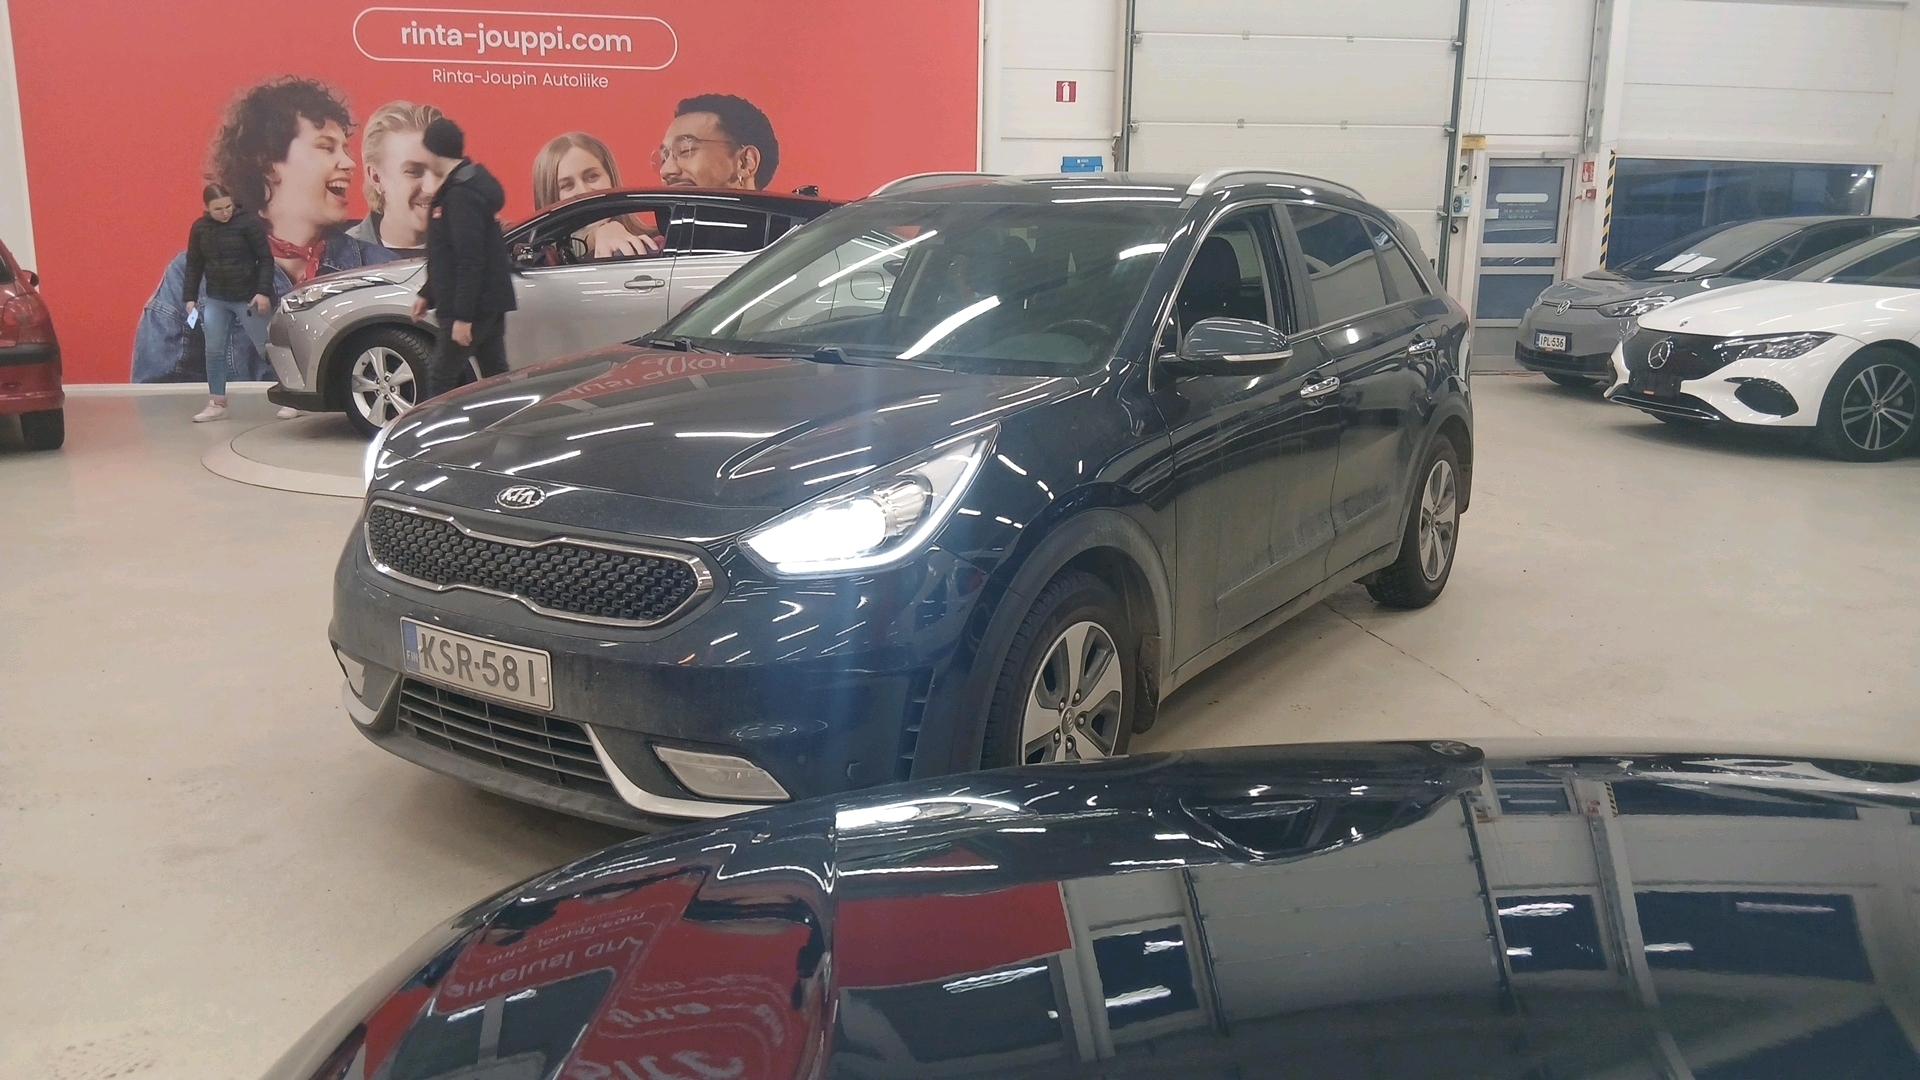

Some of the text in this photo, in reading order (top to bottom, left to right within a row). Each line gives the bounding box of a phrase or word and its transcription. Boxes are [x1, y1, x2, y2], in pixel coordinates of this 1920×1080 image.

[400, 20, 632, 56] rinta-jouppi.com
[431, 68, 609, 89] Rinta-Joupin Autoliike
[1540, 335, 1564, 348] IPL-536
[499, 487, 537, 505] KIA
[406, 650, 419, 663] FIN
[421, 633, 535, 697] KSR-581
